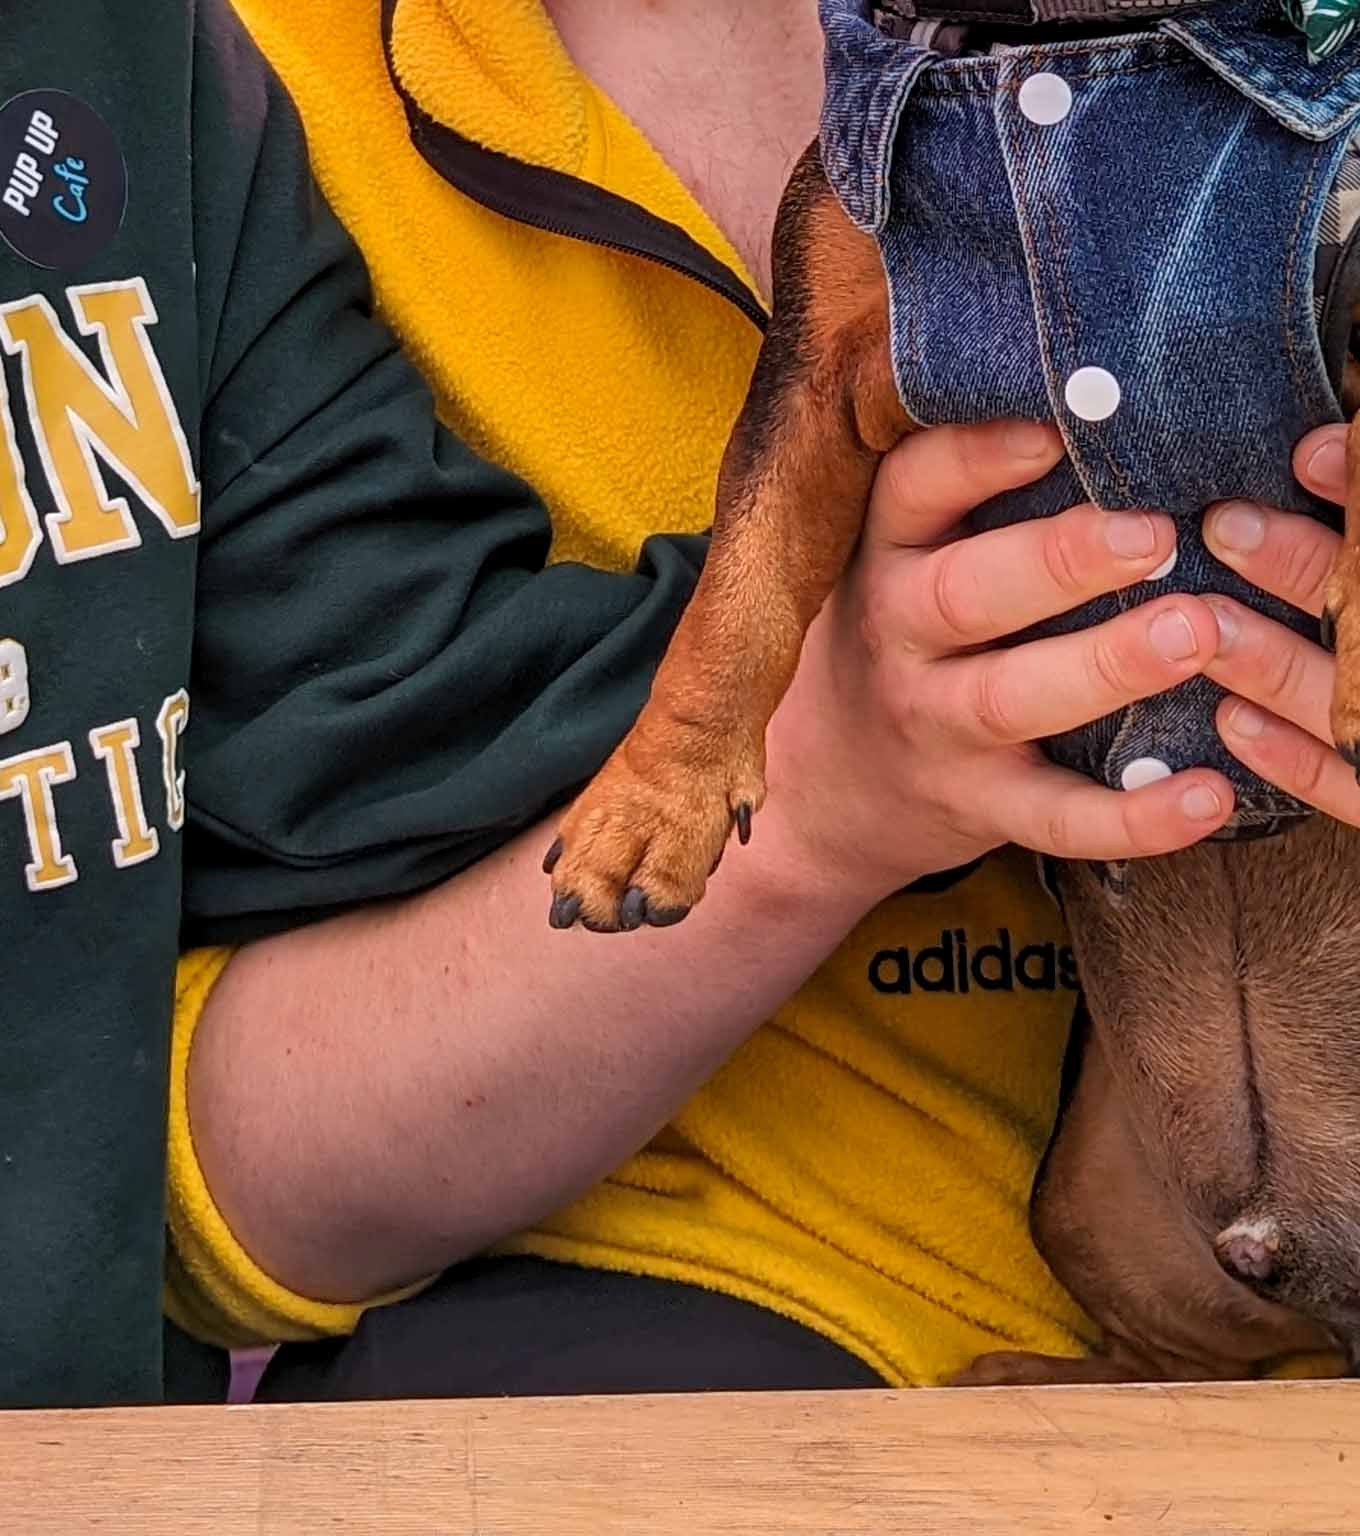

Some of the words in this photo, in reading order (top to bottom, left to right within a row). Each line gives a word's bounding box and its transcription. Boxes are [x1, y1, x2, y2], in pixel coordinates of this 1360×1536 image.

[2, 152, 44, 217] PUP
[24, 109, 60, 155] UP
[53, 156, 89, 222] Cafe
[868, 928, 1081, 994] adidas
